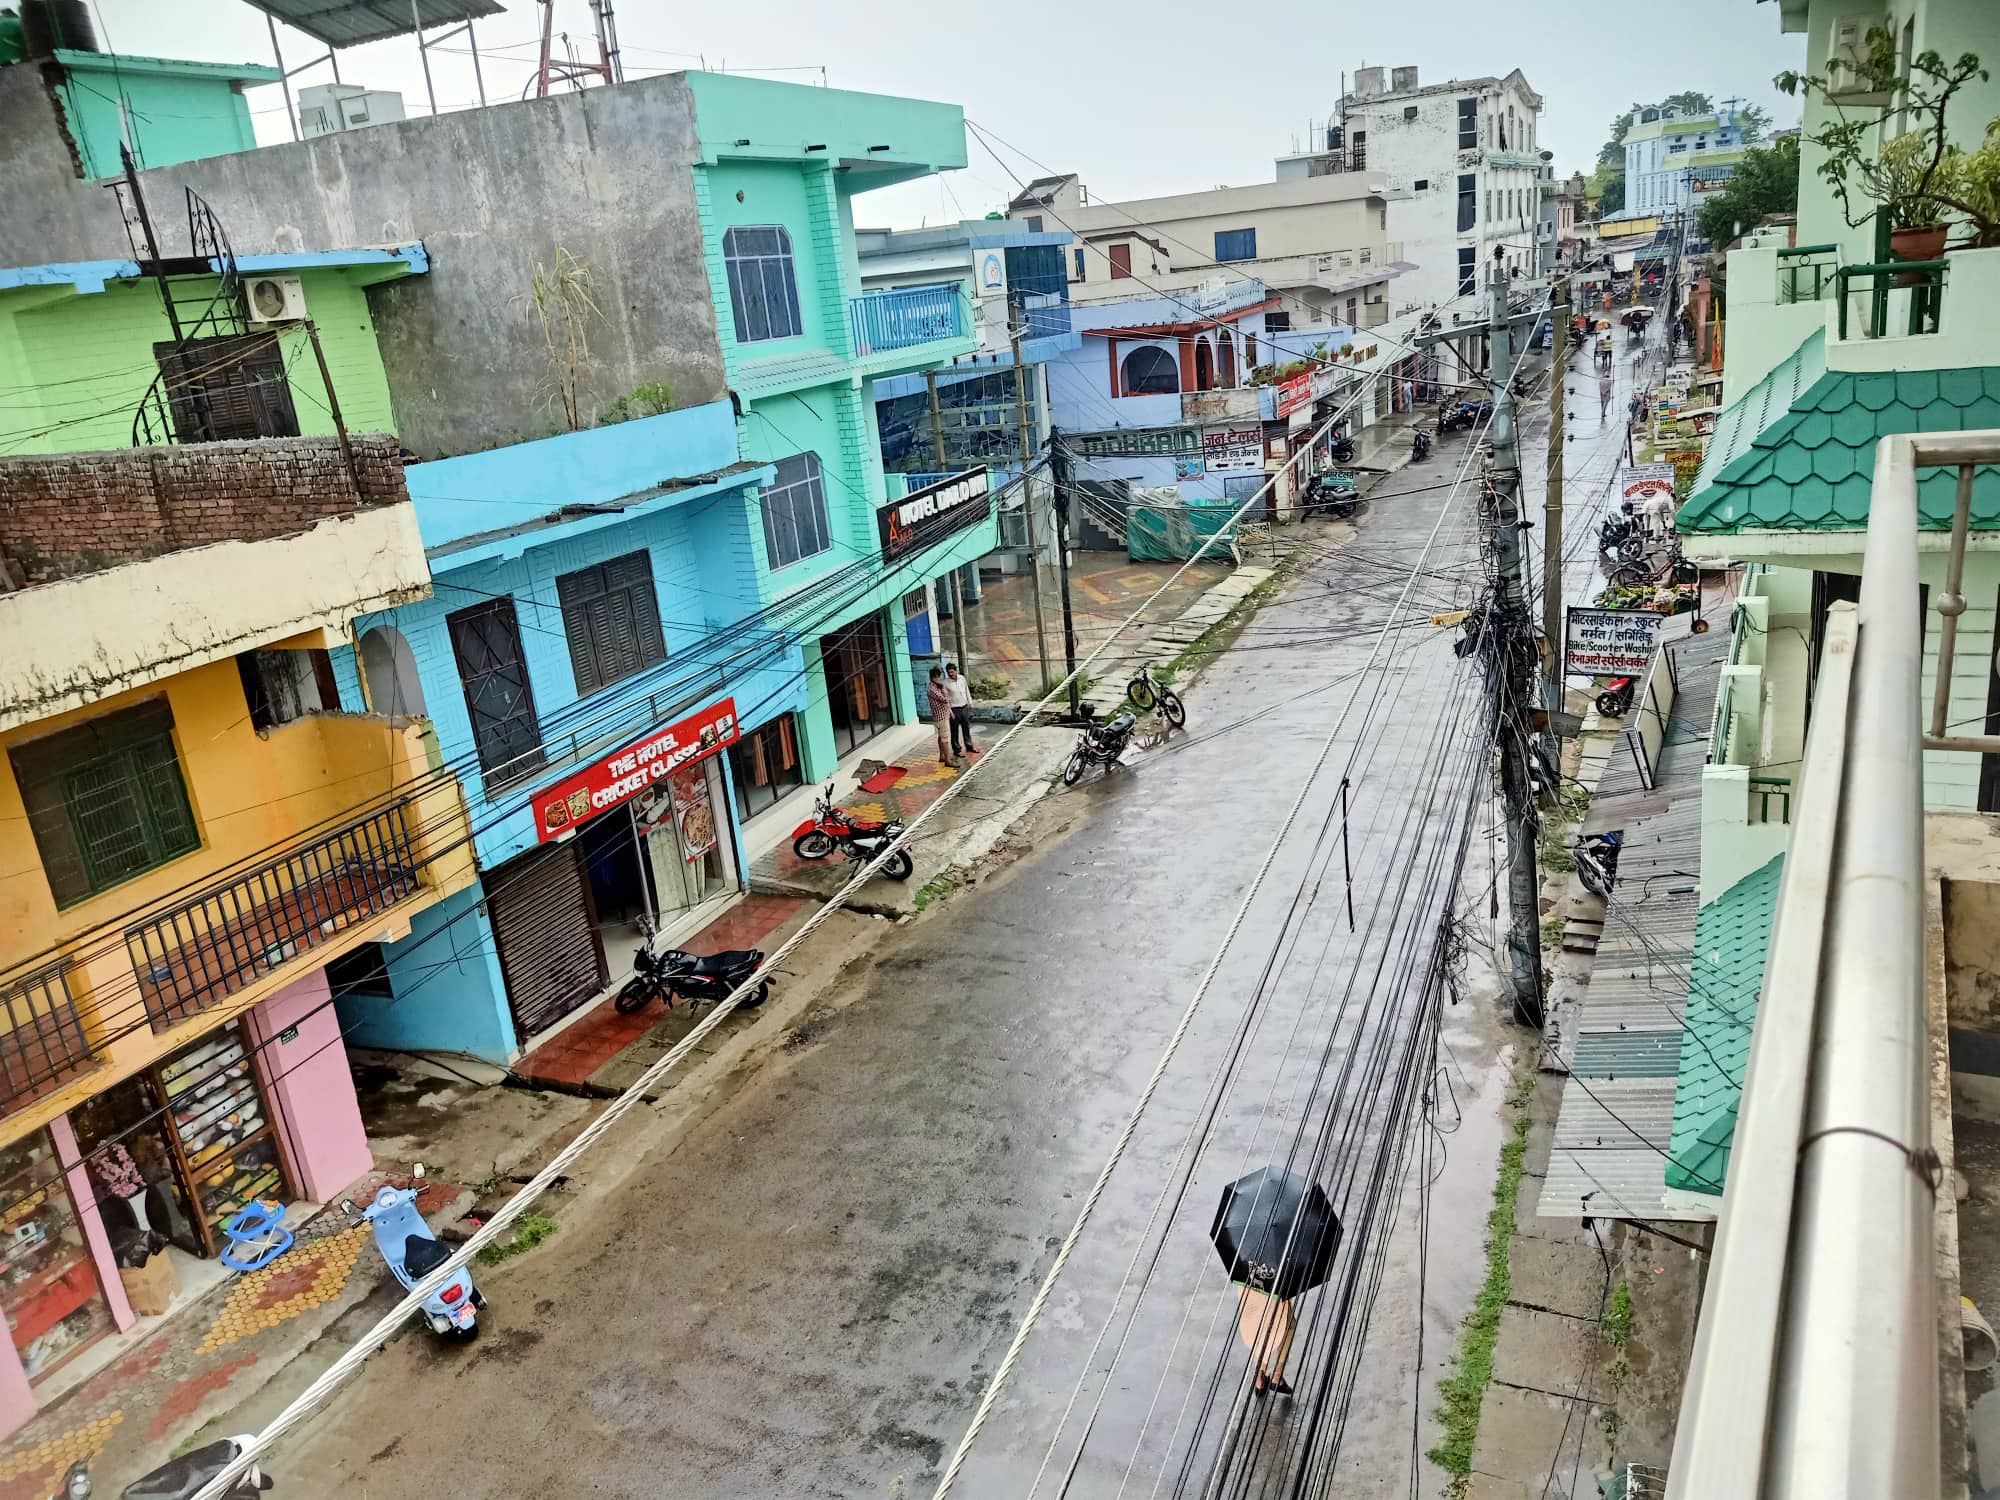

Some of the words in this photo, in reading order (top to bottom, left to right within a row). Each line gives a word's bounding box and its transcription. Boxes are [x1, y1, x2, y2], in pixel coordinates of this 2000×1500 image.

[899, 495, 937, 526] HOTEL
[608, 752, 638, 779] THE
[636, 732, 680, 765] HOTEL
[591, 767, 649, 809] CRICKET
